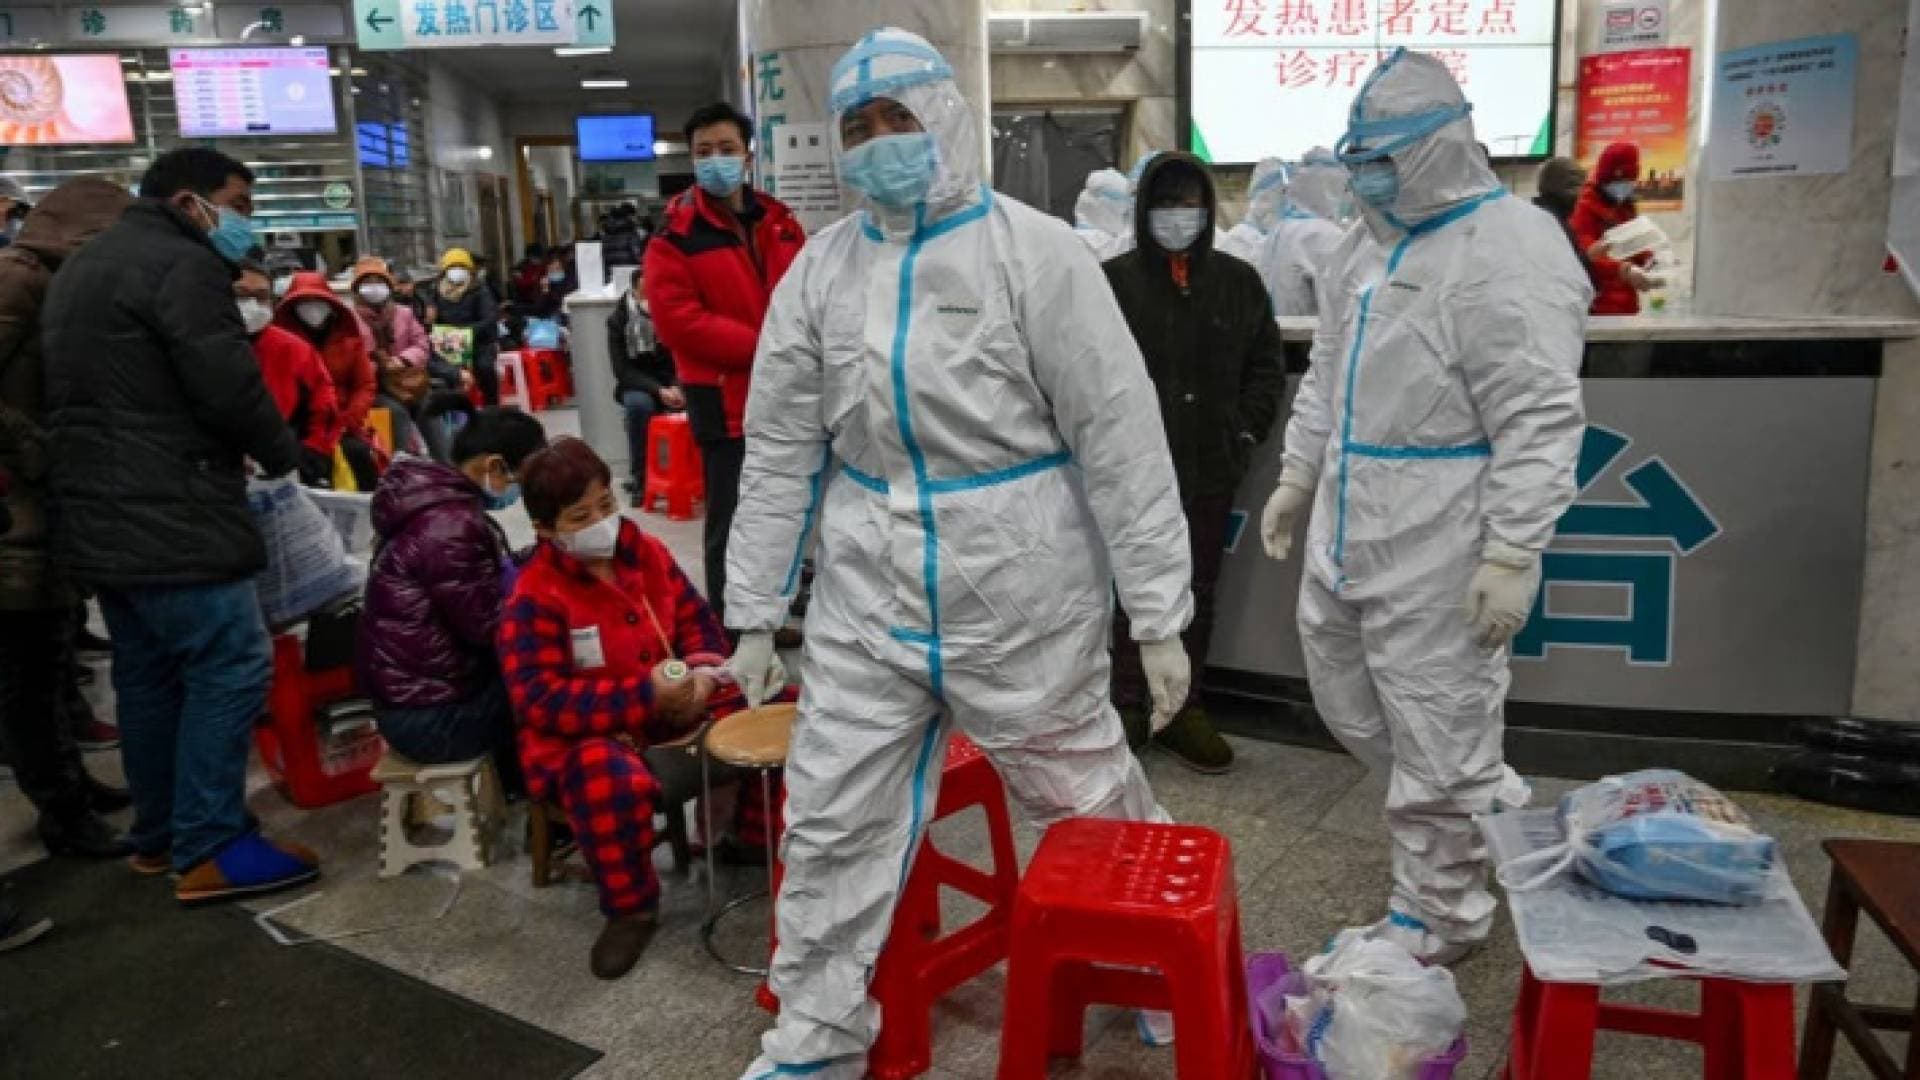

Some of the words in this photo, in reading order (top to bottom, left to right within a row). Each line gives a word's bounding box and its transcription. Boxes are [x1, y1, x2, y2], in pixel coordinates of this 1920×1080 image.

[415, 0, 559, 35] 发热门诊区
[1223, 0, 1517, 36] 发热患者定点
[1511, 424, 1724, 667] 台
